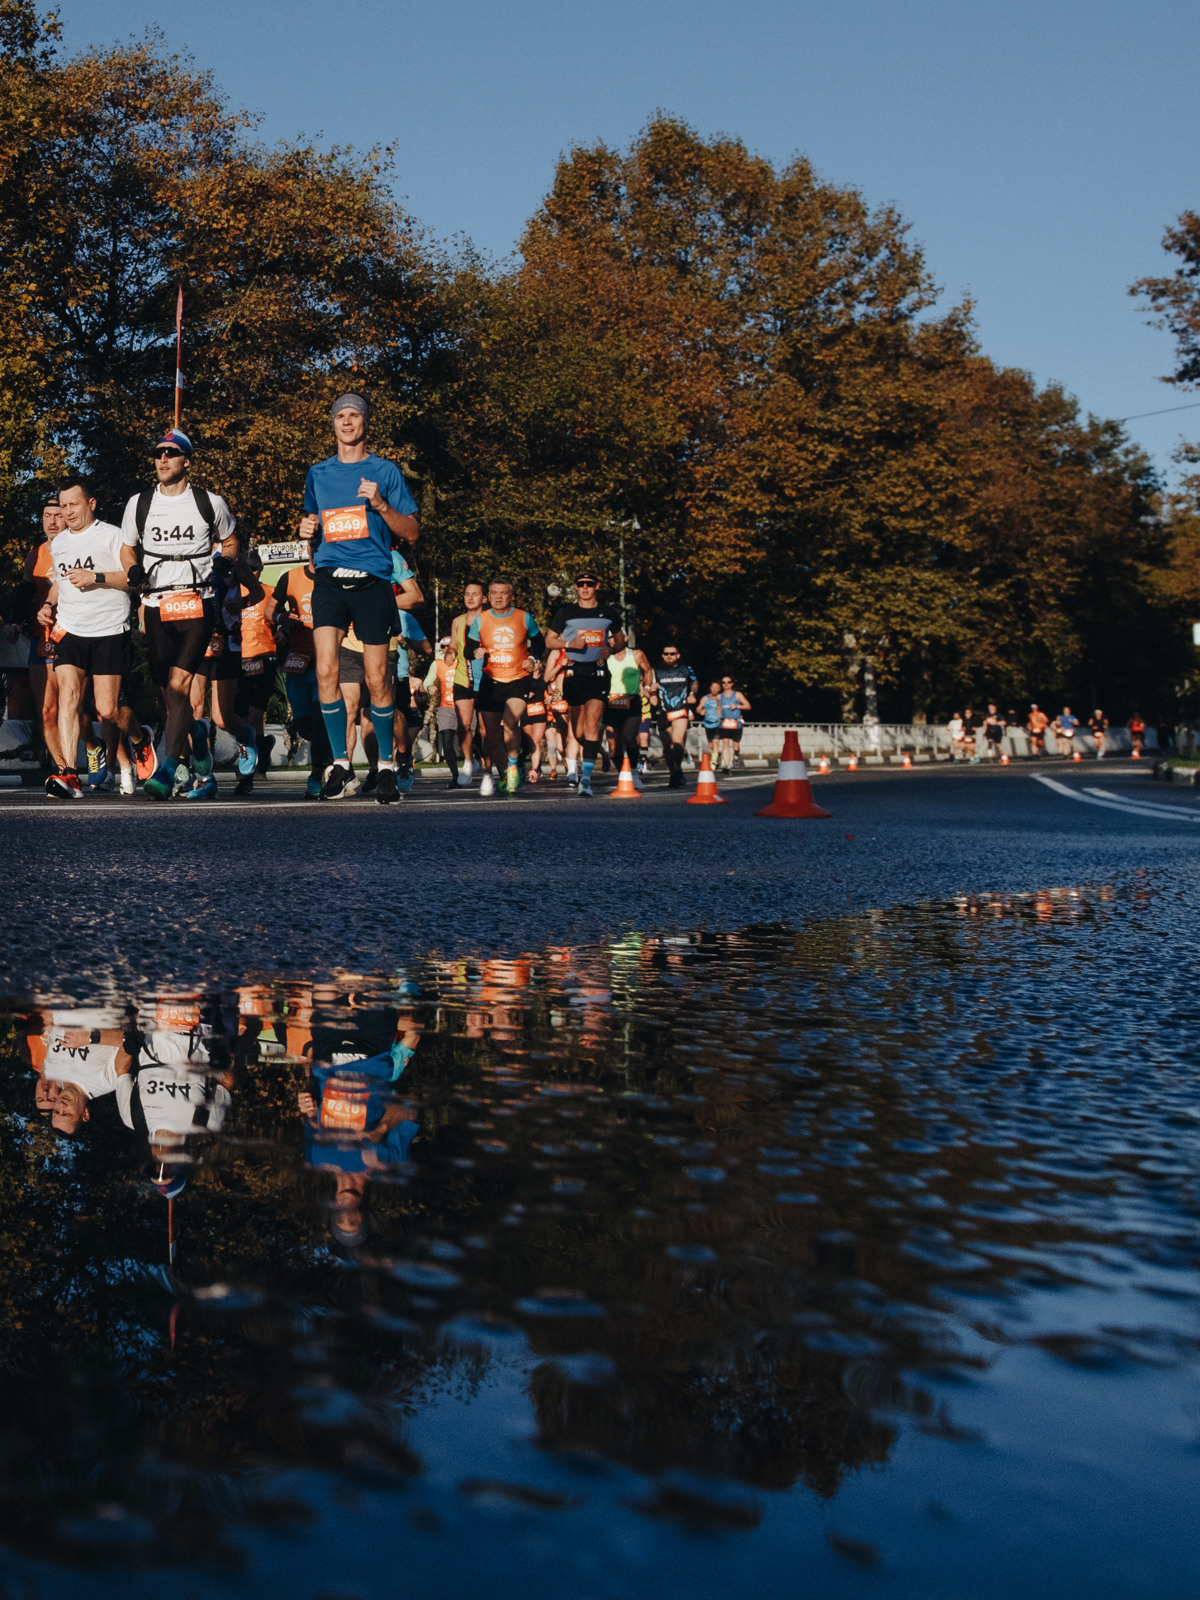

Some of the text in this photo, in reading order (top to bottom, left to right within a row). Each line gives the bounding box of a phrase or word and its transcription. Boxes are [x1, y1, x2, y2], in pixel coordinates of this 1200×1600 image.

[328, 519, 360, 533] 8349
[151, 525, 195, 542] 3:44
[165, 600, 196, 612] 9056
